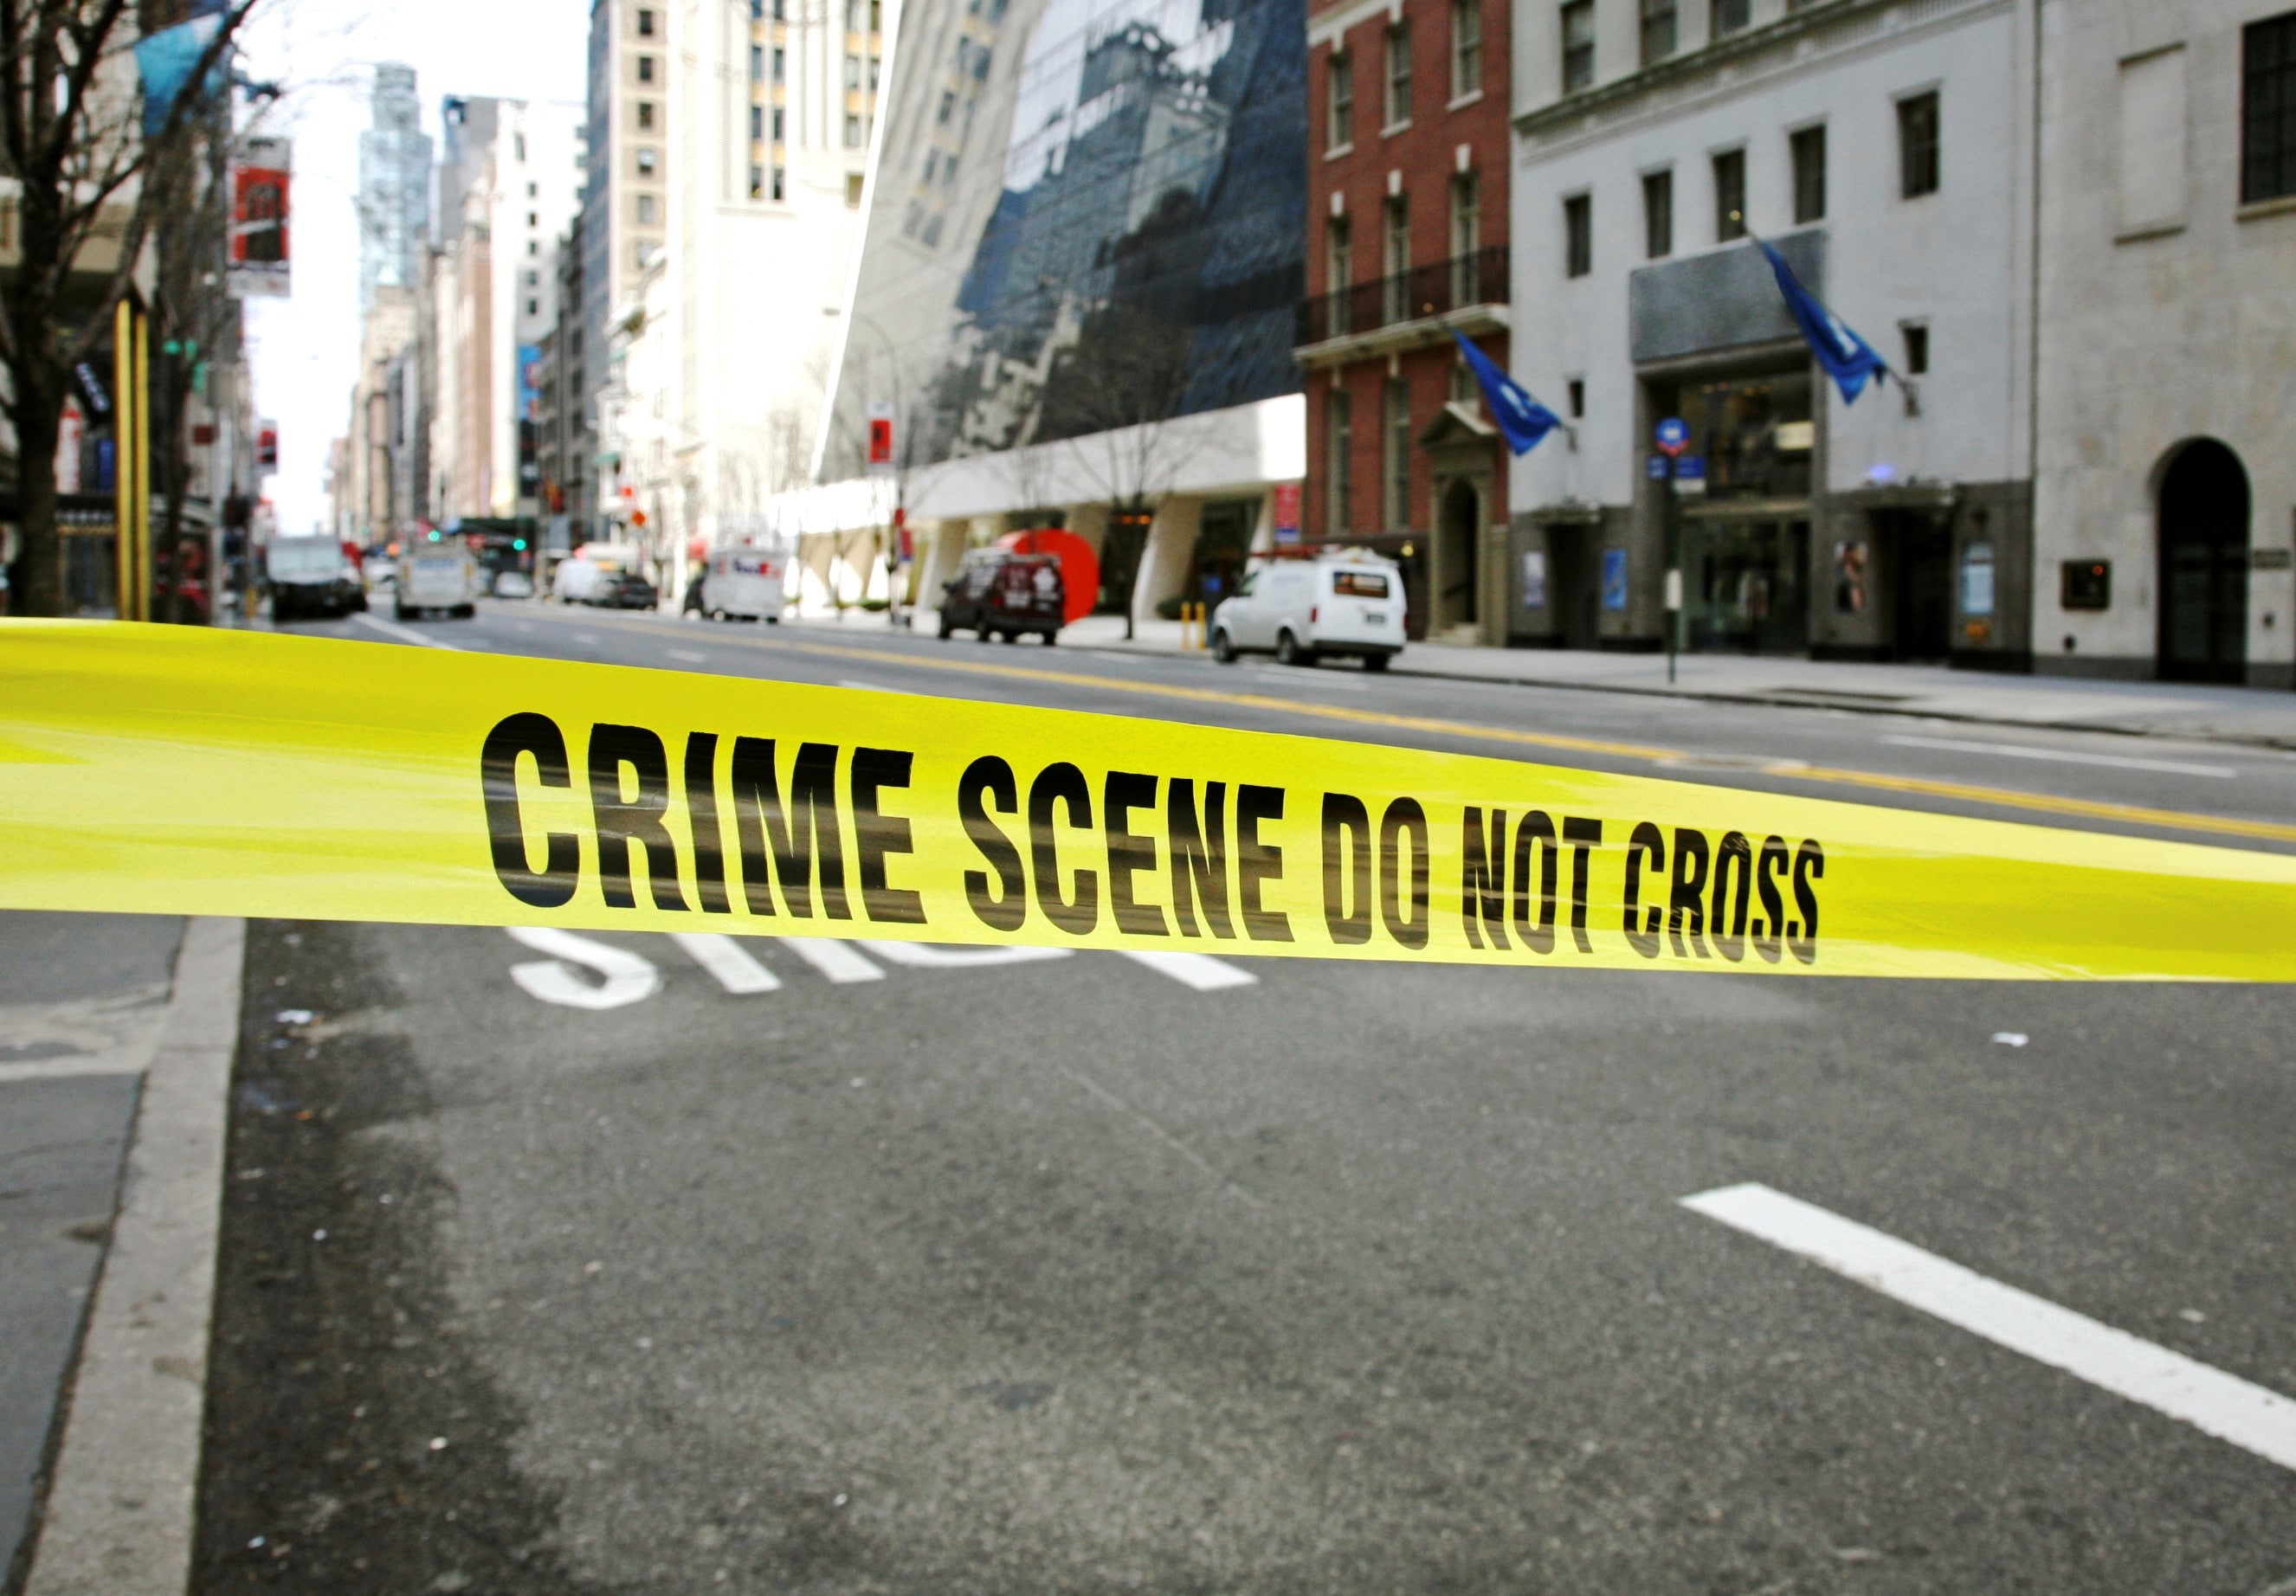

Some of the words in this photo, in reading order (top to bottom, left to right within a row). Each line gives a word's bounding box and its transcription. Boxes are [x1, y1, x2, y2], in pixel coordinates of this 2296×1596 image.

[481, 712, 927, 923] CRIME
[958, 756, 1294, 942] SCENE
[1322, 792, 1430, 950] DO
[1462, 806, 1603, 955] NOT
[1622, 821, 1824, 965] CROSS
